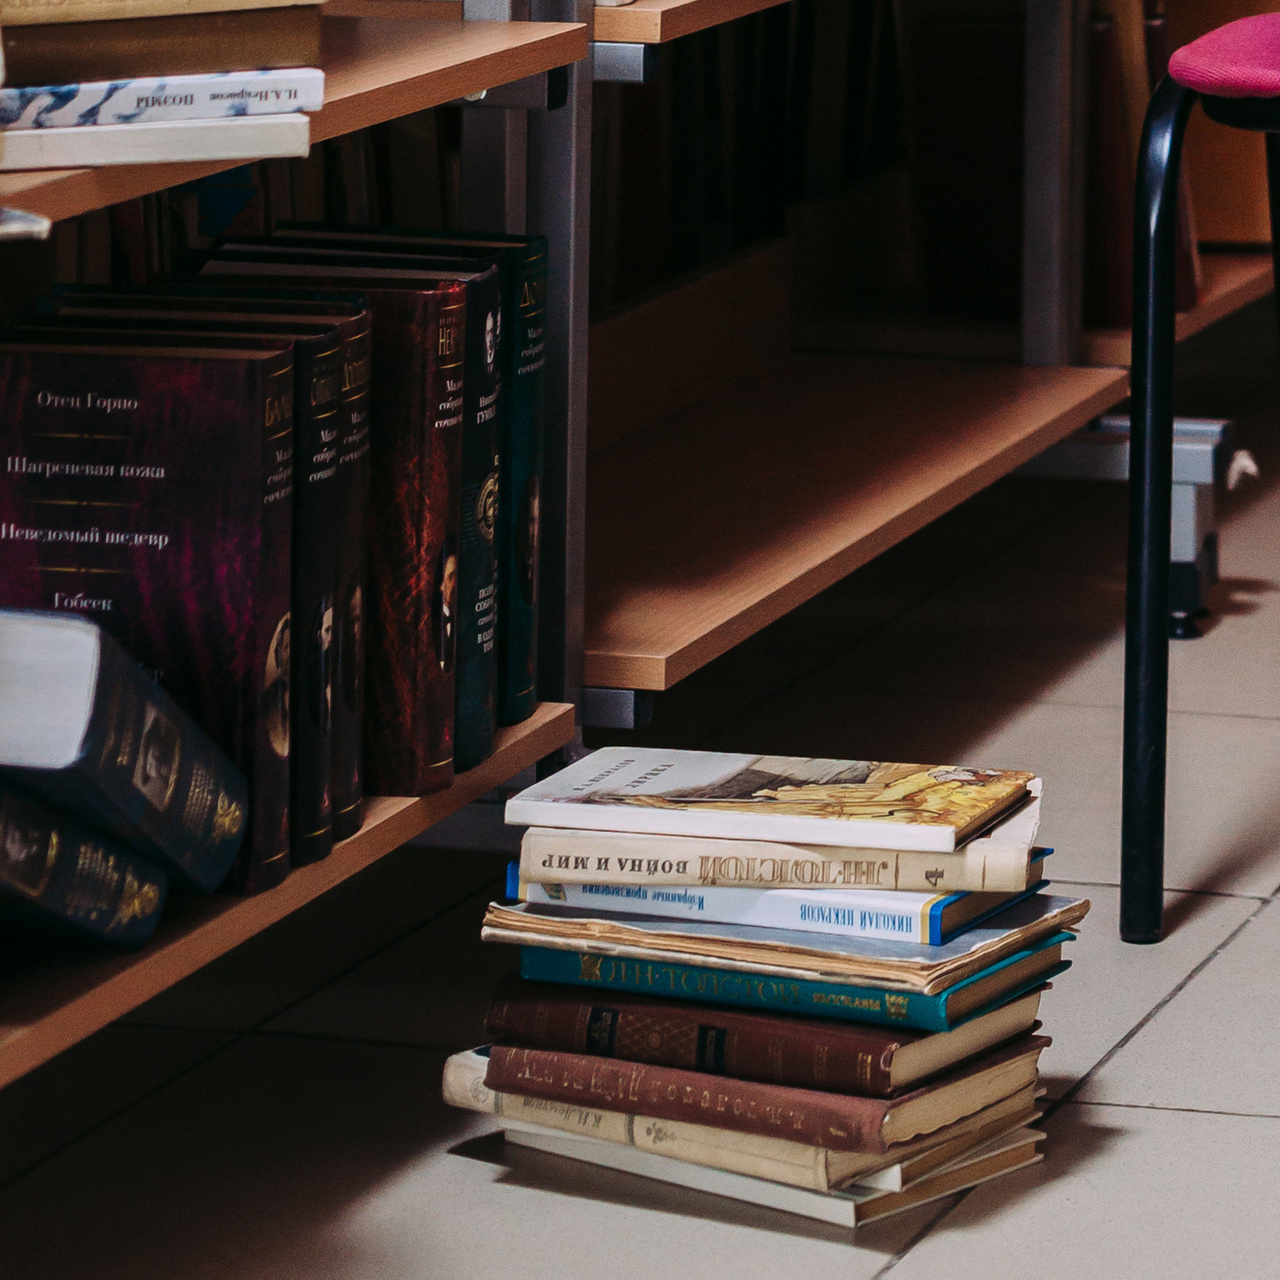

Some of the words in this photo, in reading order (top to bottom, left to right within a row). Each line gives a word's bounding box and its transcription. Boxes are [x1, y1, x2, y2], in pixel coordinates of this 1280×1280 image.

[135, 92, 196, 111] ПОЭМЫ
[36, 390, 80, 410] Отец
[86, 391, 139, 414] Горио
[6, 455, 114, 481] Шагреневая
[119, 462, 166, 481] кожа
[104, 529, 170, 551] шедевр
[54, 592, 114, 612] Гобсек
[541, 853, 590, 869] МИР
[596, 856, 611, 871] И
[617, 857, 689, 876] ВОЙНА
[799, 903, 855, 927] НЕКРАСОВ
[859, 910, 913, 934] НИКОЛАЙ
